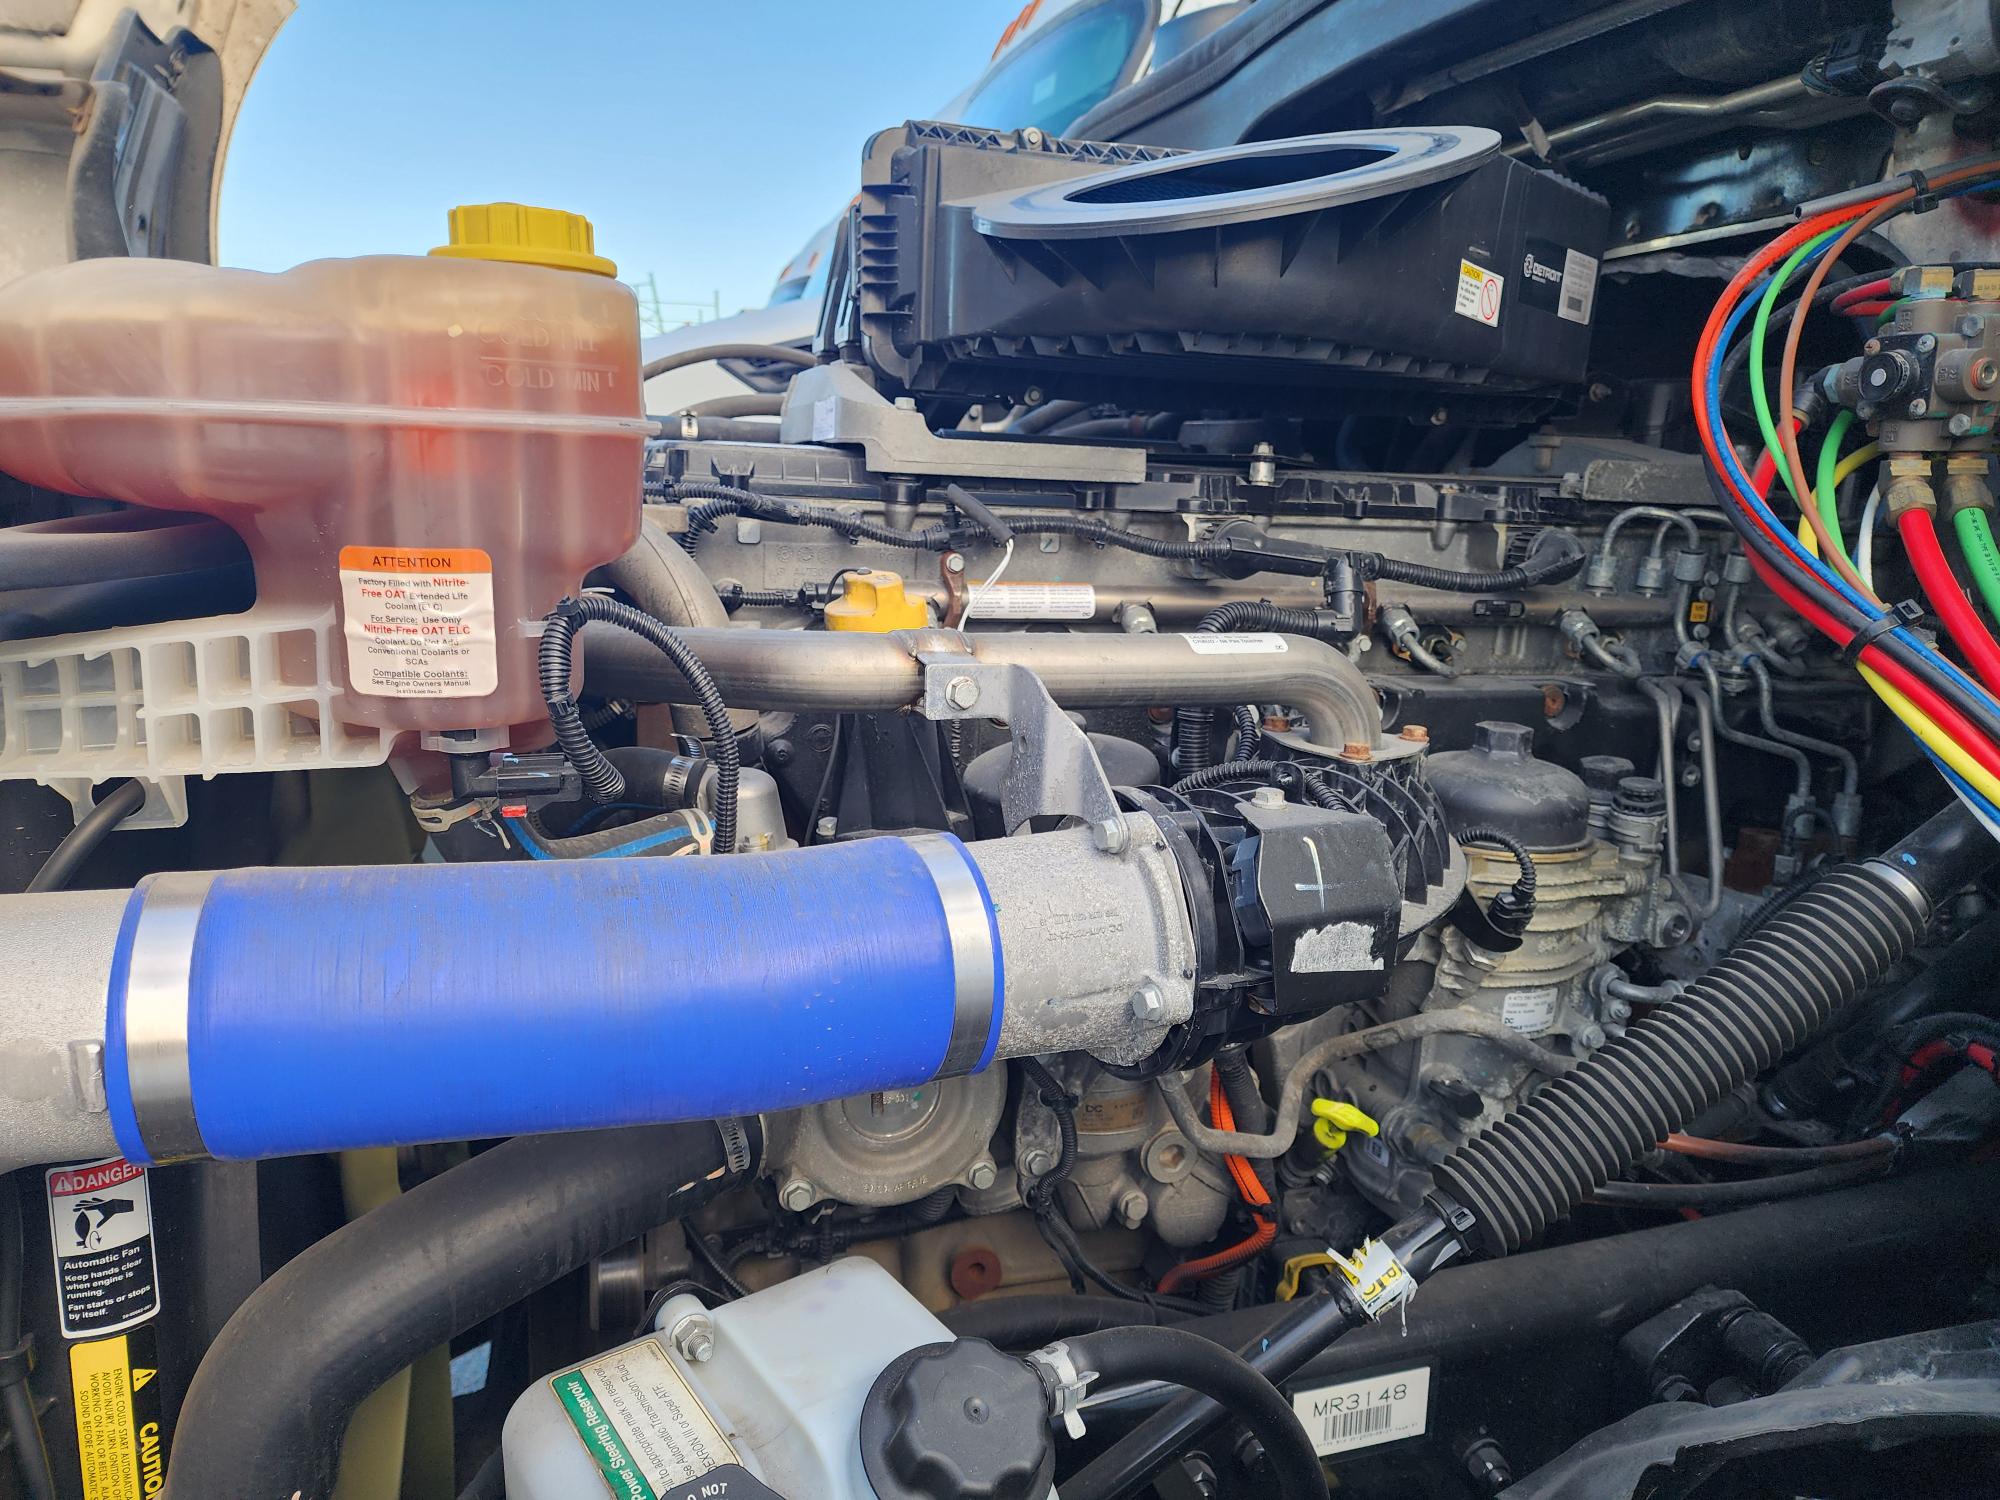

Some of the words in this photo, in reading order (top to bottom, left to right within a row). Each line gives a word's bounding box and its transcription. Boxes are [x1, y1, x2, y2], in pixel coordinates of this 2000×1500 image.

[1533, 263, 1562, 282] DETROIT
[486, 363, 554, 389] COLD
[373, 556, 450, 568] ATTENTION
[359, 578, 386, 587] Factory
[389, 579, 410, 587] Filled
[433, 578, 469, 586] Nitrite-
[362, 589, 381, 597] Free
[385, 590, 406, 598] OAT
[364, 624, 417, 635] Nitrite-Free
[422, 626, 445, 635] OAT
[449, 625, 470, 635] ELC
[368, 647, 418, 655] Conventional
[373, 669, 420, 678] Compatible
[64, 1253, 119, 1271] Automatic
[121, 1245, 140, 1259] Fan
[65, 1273, 89, 1284] Keep
[91, 1267, 119, 1280] hands
[121, 1258, 143, 1271] clear
[66, 1280, 90, 1291] when
[92, 1274, 124, 1287] engine
[126, 1270, 134, 1279] is
[66, 1288, 105, 1300] running.
[68, 1302, 86, 1312] Fan
[86, 1297, 115, 1310] starts
[116, 1293, 126, 1303] or
[128, 1285, 151, 1299] stops
[68, 1310, 81, 1321] by
[82, 1306, 109, 1319] itself.
[90, 1373, 101, 1412] WORKING
[102, 1372, 111, 1396] AVOID
[113, 1368, 124, 1398] ENGINE
[80, 1390, 90, 1418] SOUND
[566, 1380, 598, 1427] Reservoir
[611, 1396, 624, 1409] on
[628, 1380, 662, 1429] Transmission
[664, 1399, 684, 1421] Super
[1313, 1384, 1407, 1418] MR3148
[93, 1415, 102, 1428] ON
[105, 1398, 115, 1427] INJURY,
[116, 1400, 127, 1426] COULD
[617, 1407, 636, 1428] mark
[83, 1420, 93, 1448] BEFORE
[678, 1419, 690, 1432] or
[96, 1430, 104, 1445] FAN
[107, 1429, 117, 1449] TURN
[119, 1429, 128, 1450] START
[594, 1422, 626, 1470] Steering
[629, 1425, 666, 1471] appropriate
[657, 1426, 687, 1466] Automatic
[97, 1448, 105, 1459] OR
[86, 1451, 98, 1494] AUTOMATIC
[98, 1461, 108, 1484] BELTS.
[109, 1451, 120, 1487] IGNITION
[658, 1469, 669, 1480] to
[619, 1469, 647, 1500] Power
[701, 1482, 728, 1498] NOT
